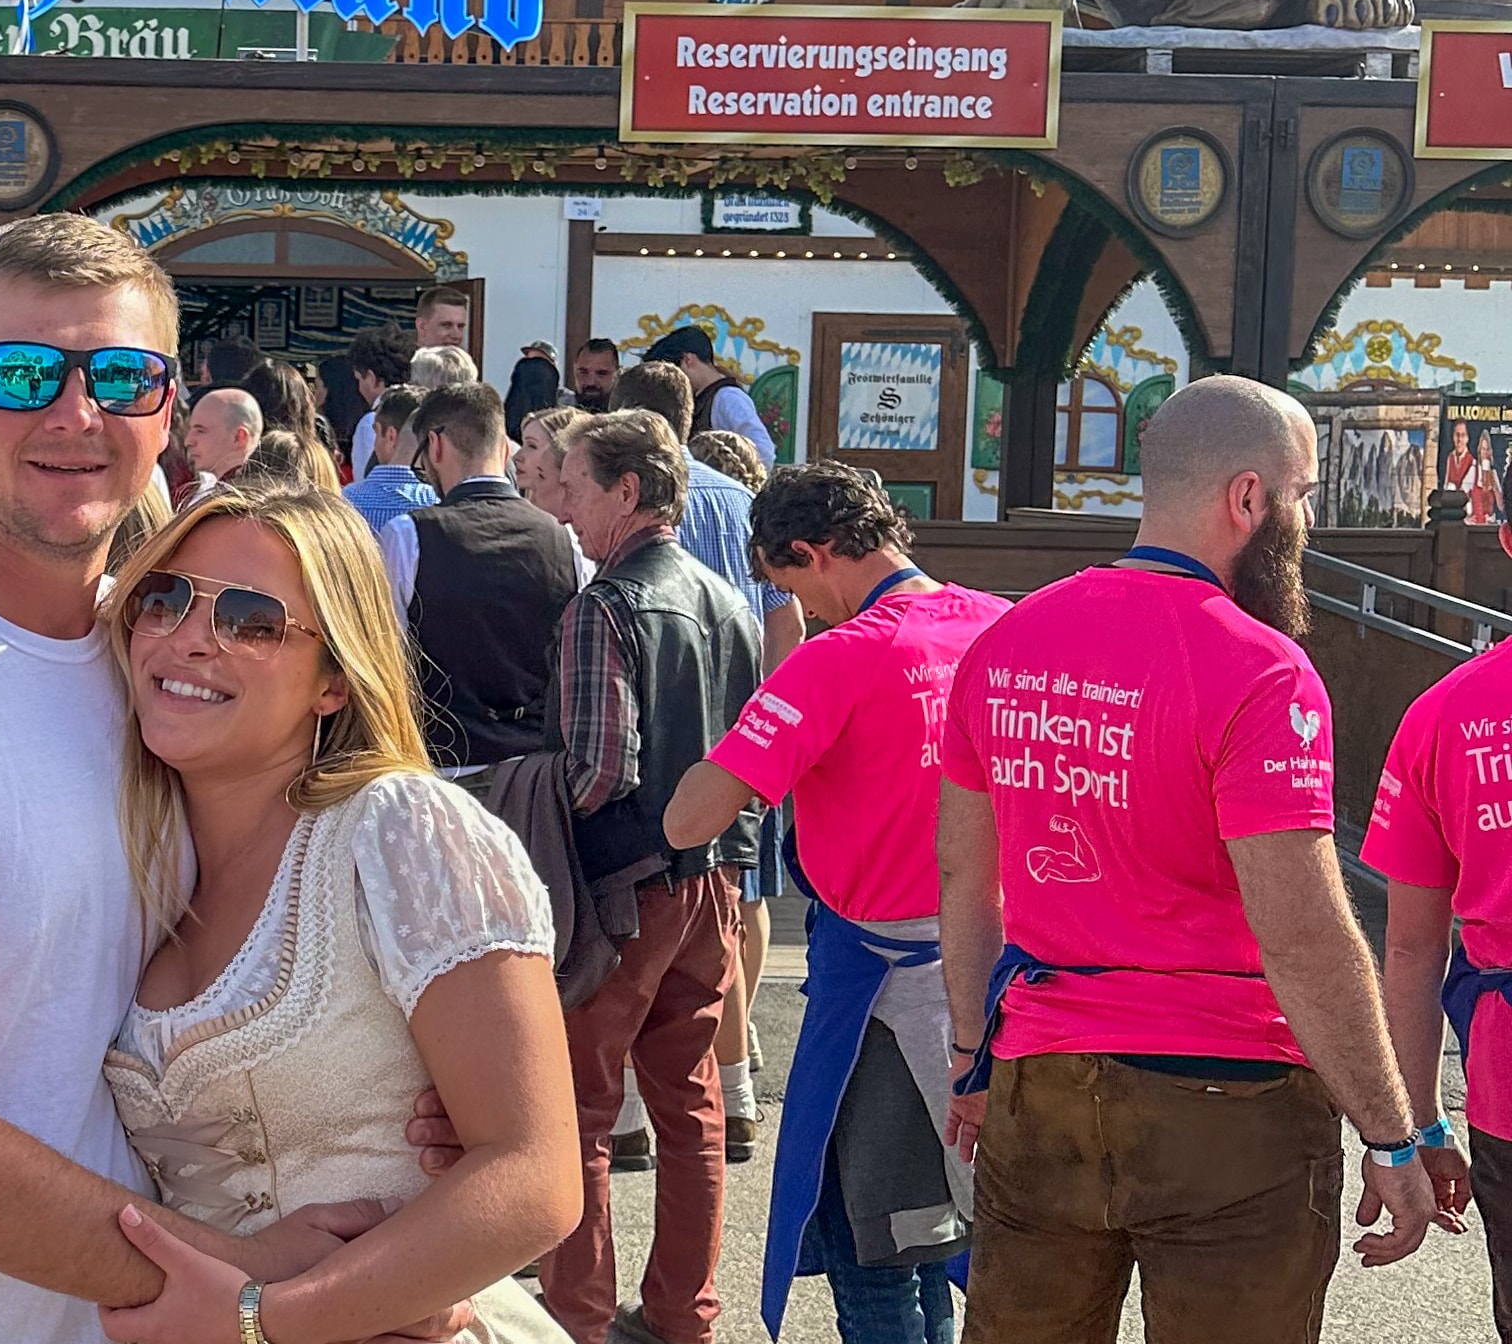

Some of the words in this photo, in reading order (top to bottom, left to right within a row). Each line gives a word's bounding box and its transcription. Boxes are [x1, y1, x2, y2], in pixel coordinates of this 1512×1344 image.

[675, 34, 1008, 80] Reservierungseingang
[687, 84, 858, 117] Reservation
[866, 89, 993, 119] entrance
[859, 412, 916, 424] Schöniger
[903, 664, 933, 685] Wir
[987, 667, 1012, 688] Wir
[1013, 668, 1047, 693] sind
[1051, 672, 1078, 697] alle
[1081, 680, 1145, 710] trainiert!
[986, 697, 1092, 749] Trinken
[1098, 712, 1135, 761] ist
[1459, 717, 1497, 741] Wir
[990, 747, 1045, 790] auch
[1053, 754, 1129, 809] Sport!
[1263, 759, 1288, 774] Der
[1465, 743, 1512, 785] Tri
